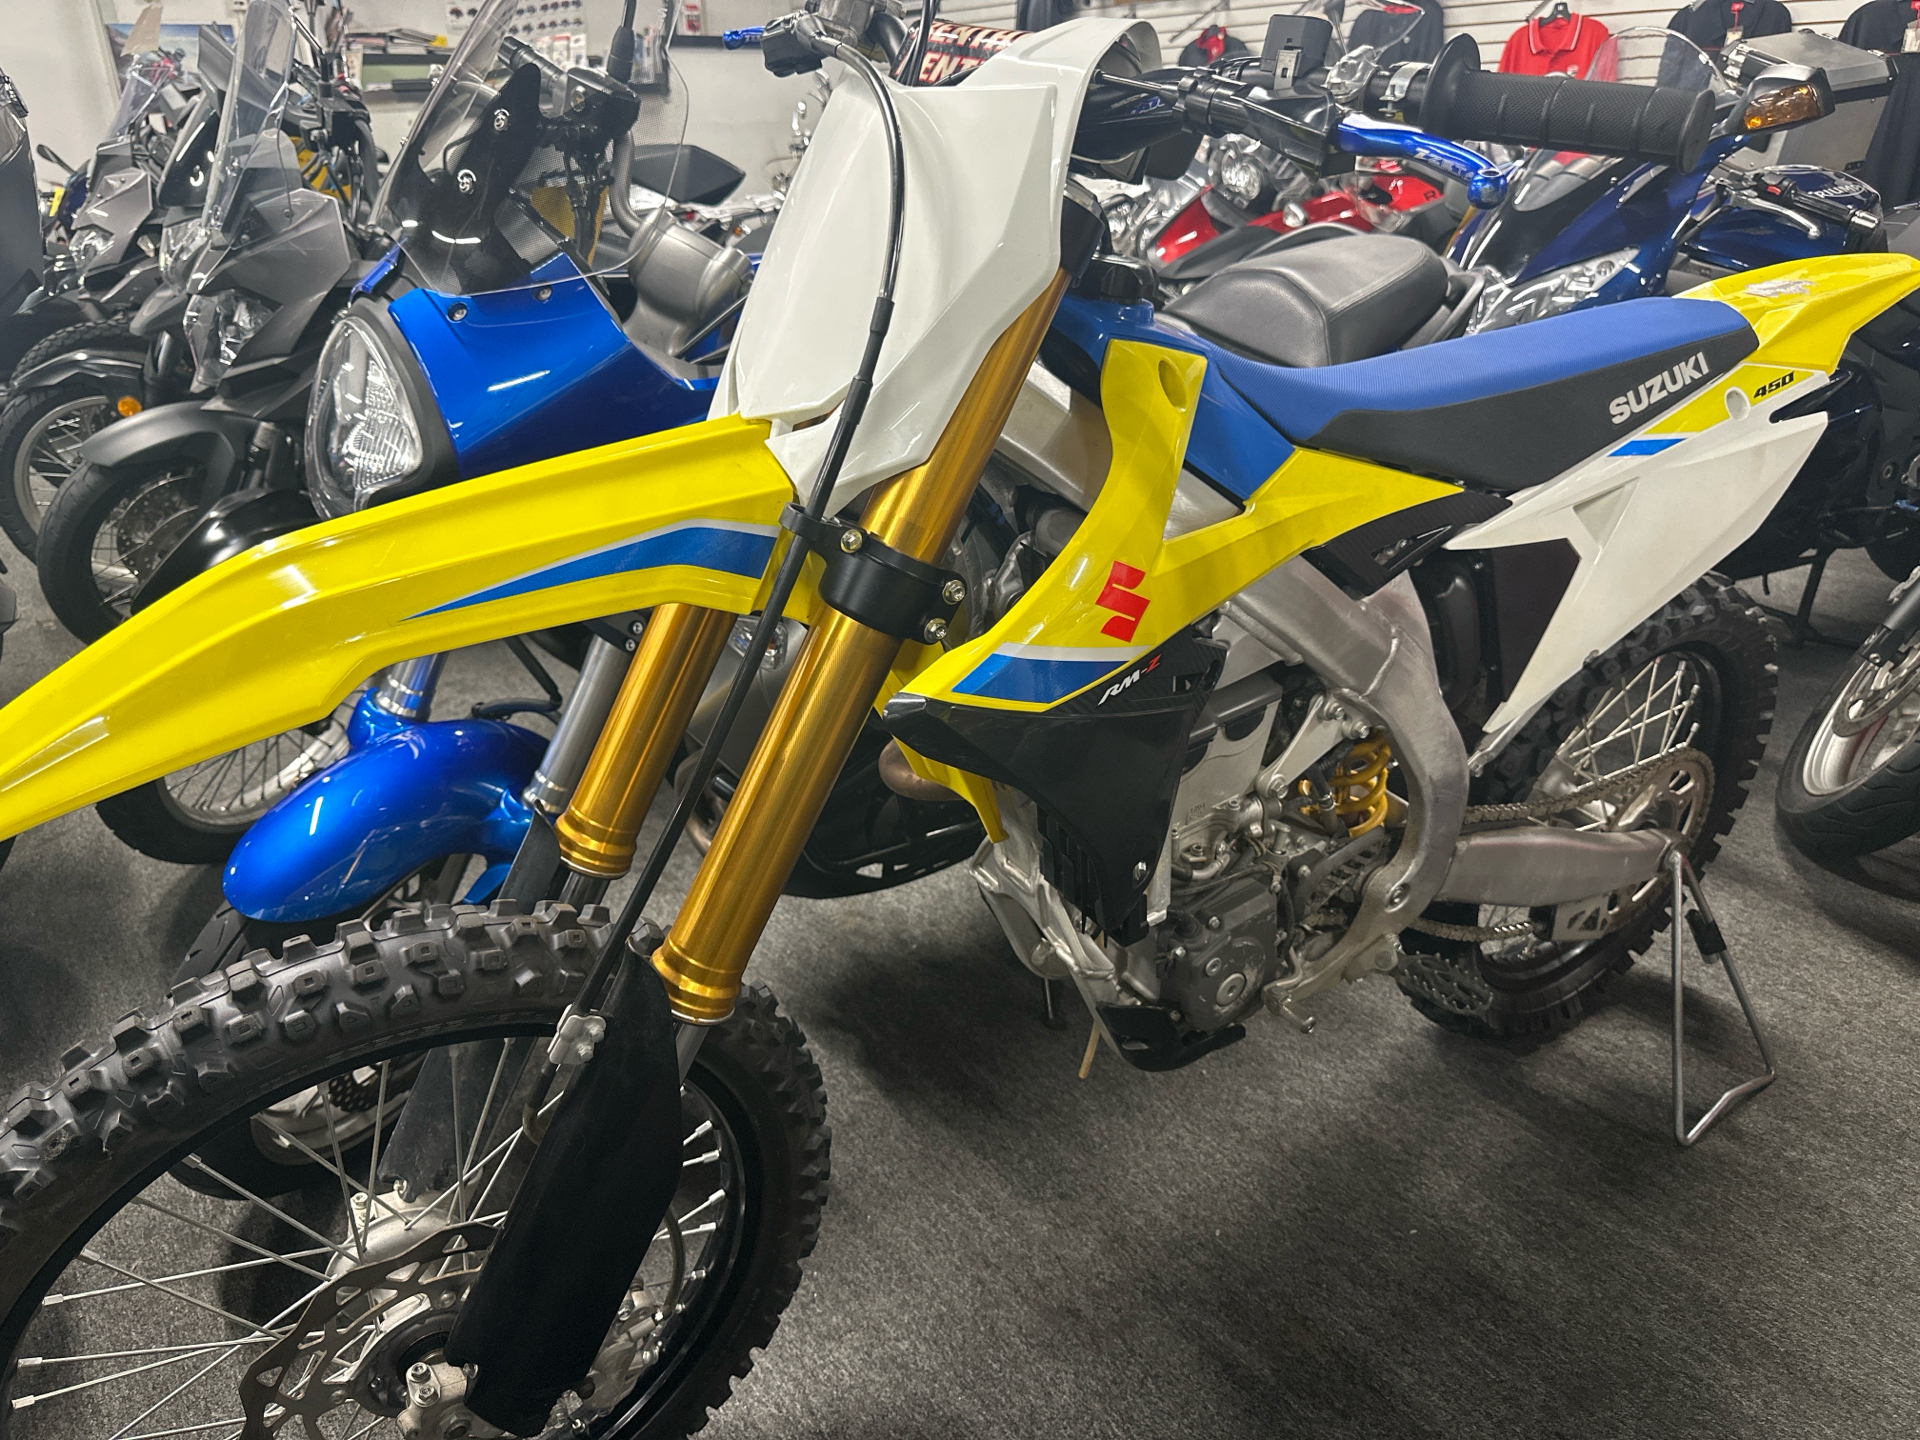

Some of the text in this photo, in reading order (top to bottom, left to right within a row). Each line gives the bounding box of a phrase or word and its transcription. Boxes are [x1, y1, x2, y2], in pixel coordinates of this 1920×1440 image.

[1609, 352, 1709, 425] SUZUKI
[1753, 371, 1795, 399] 450
[1097, 653, 1162, 706] RM-Z
